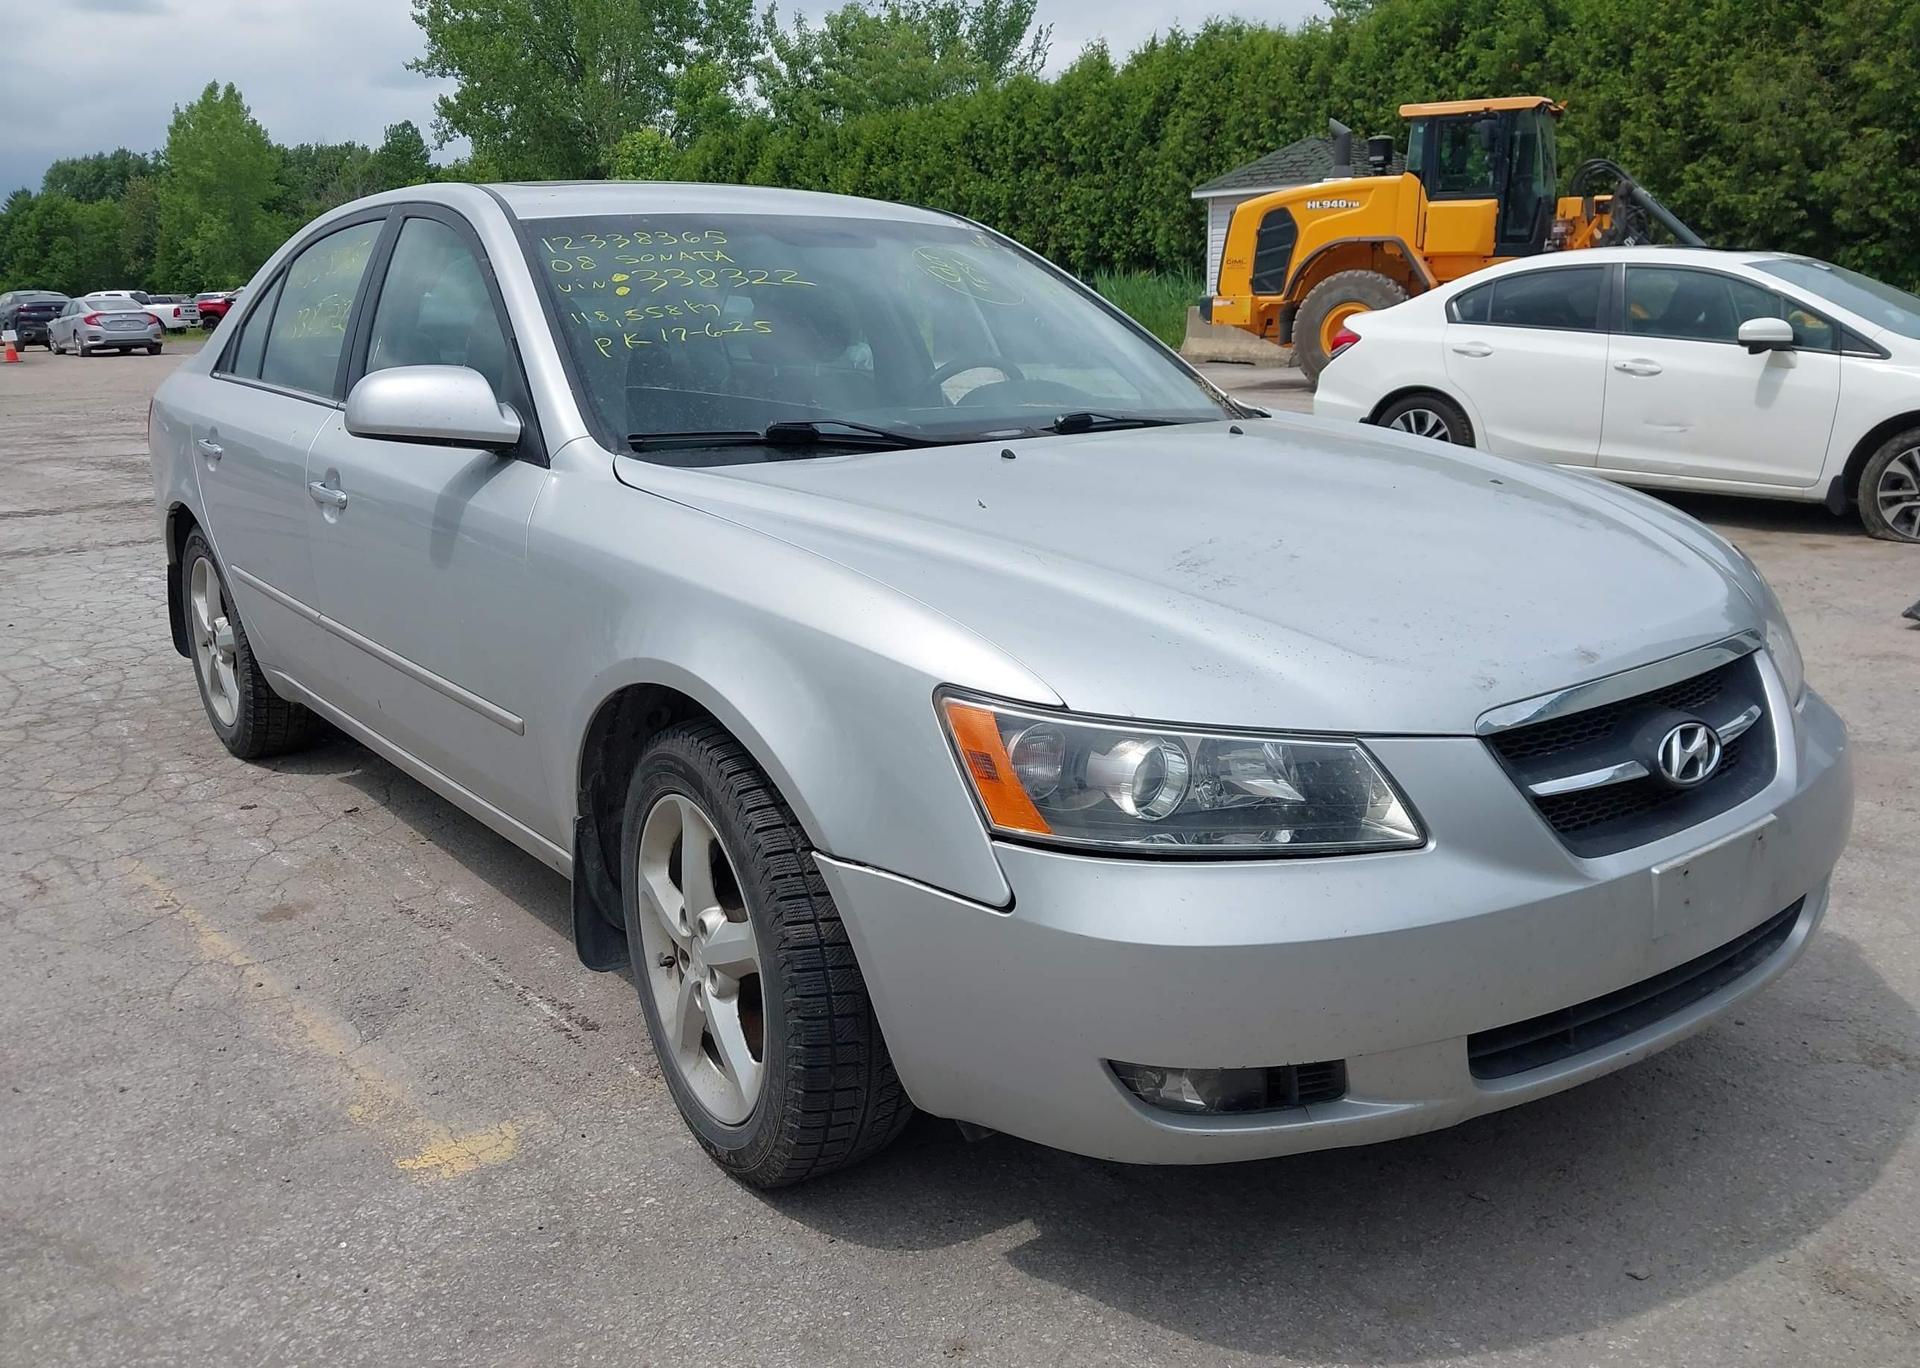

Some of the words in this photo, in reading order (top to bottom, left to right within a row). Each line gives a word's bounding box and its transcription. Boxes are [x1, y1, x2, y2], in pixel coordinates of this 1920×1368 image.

[542, 231, 728, 253] 12338365
[552, 256, 597, 272] 08
[615, 251, 735, 264] SONATA
[631, 269, 817, 292] 338322
